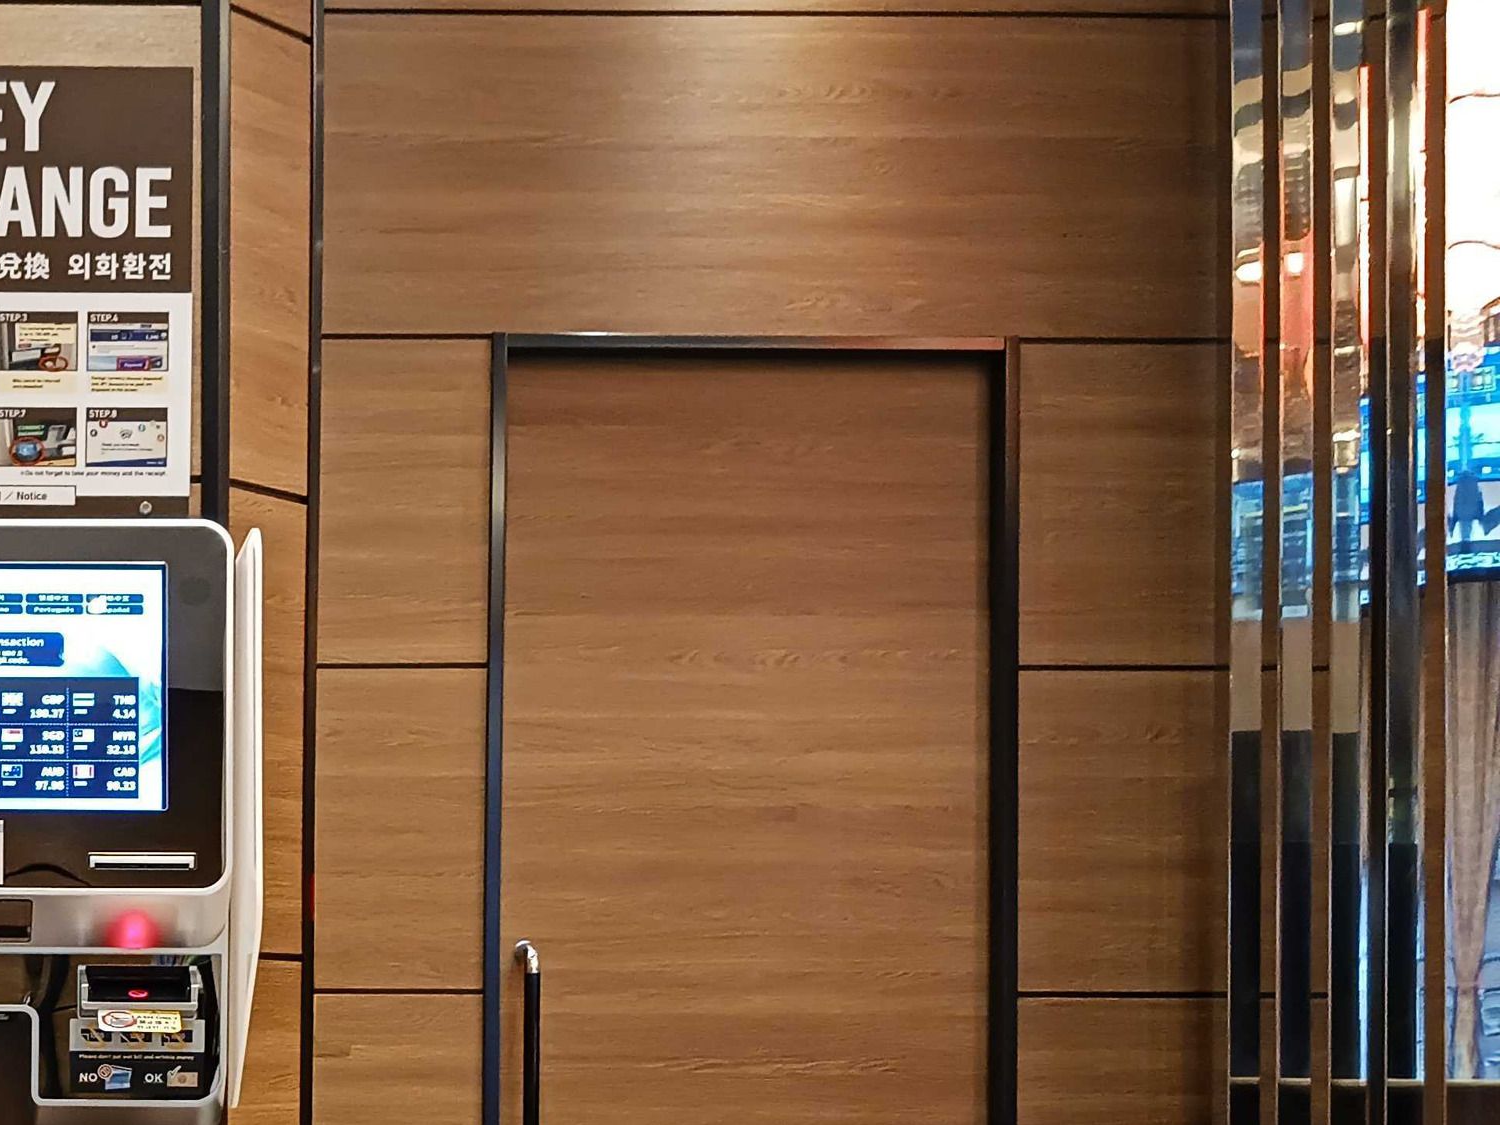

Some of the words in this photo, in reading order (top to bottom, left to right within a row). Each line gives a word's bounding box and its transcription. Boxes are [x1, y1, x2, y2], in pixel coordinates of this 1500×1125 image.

[67, 252, 172, 280] 외화환전
[0, 313, 28, 322] STEP.3
[90, 314, 118, 322] STEP.4
[89, 410, 117, 418] STEP.8
[17, 491, 47, 500] Notice
[113, 767, 136, 776] CAD
[79, 1072, 98, 1082] NO
[144, 1074, 163, 1083] OK
